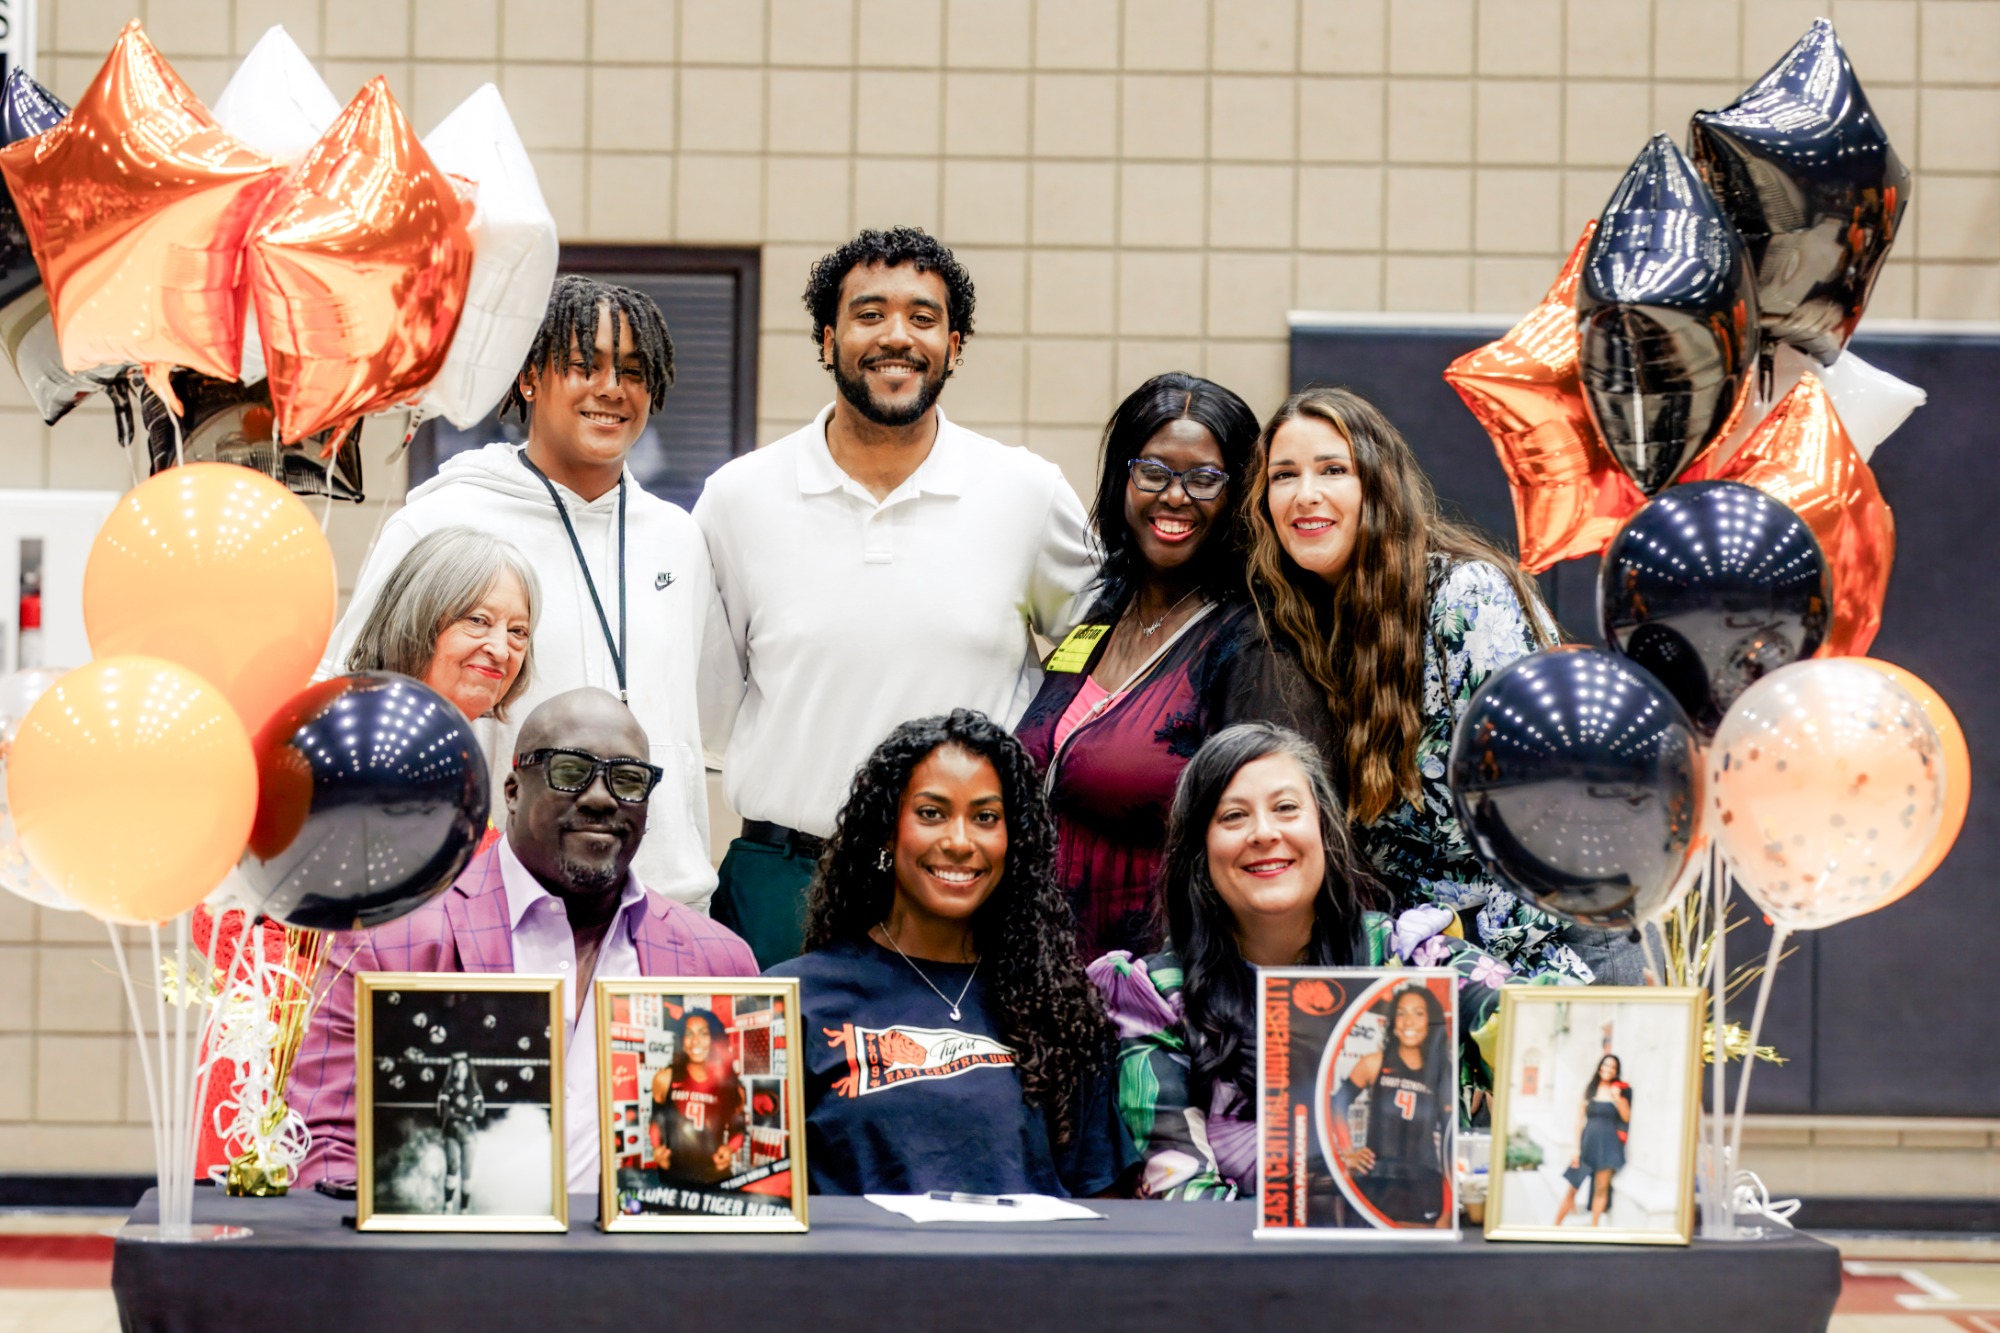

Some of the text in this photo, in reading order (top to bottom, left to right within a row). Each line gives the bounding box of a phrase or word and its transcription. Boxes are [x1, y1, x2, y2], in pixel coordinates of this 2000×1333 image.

[657, 572, 672, 583] NIKE
[930, 1035, 978, 1064] Tigers
[886, 1067, 922, 1084] EAST
[924, 1053, 988, 1077] CENTRAL
[1264, 977, 1290, 1227] EAST CENTRAL UNIVERSITY
[1394, 1089, 1417, 1121] 4
[680, 1190, 701, 1210] TO
[702, 1194, 744, 1216] TIGER
[745, 1201, 793, 1216] NATIO
